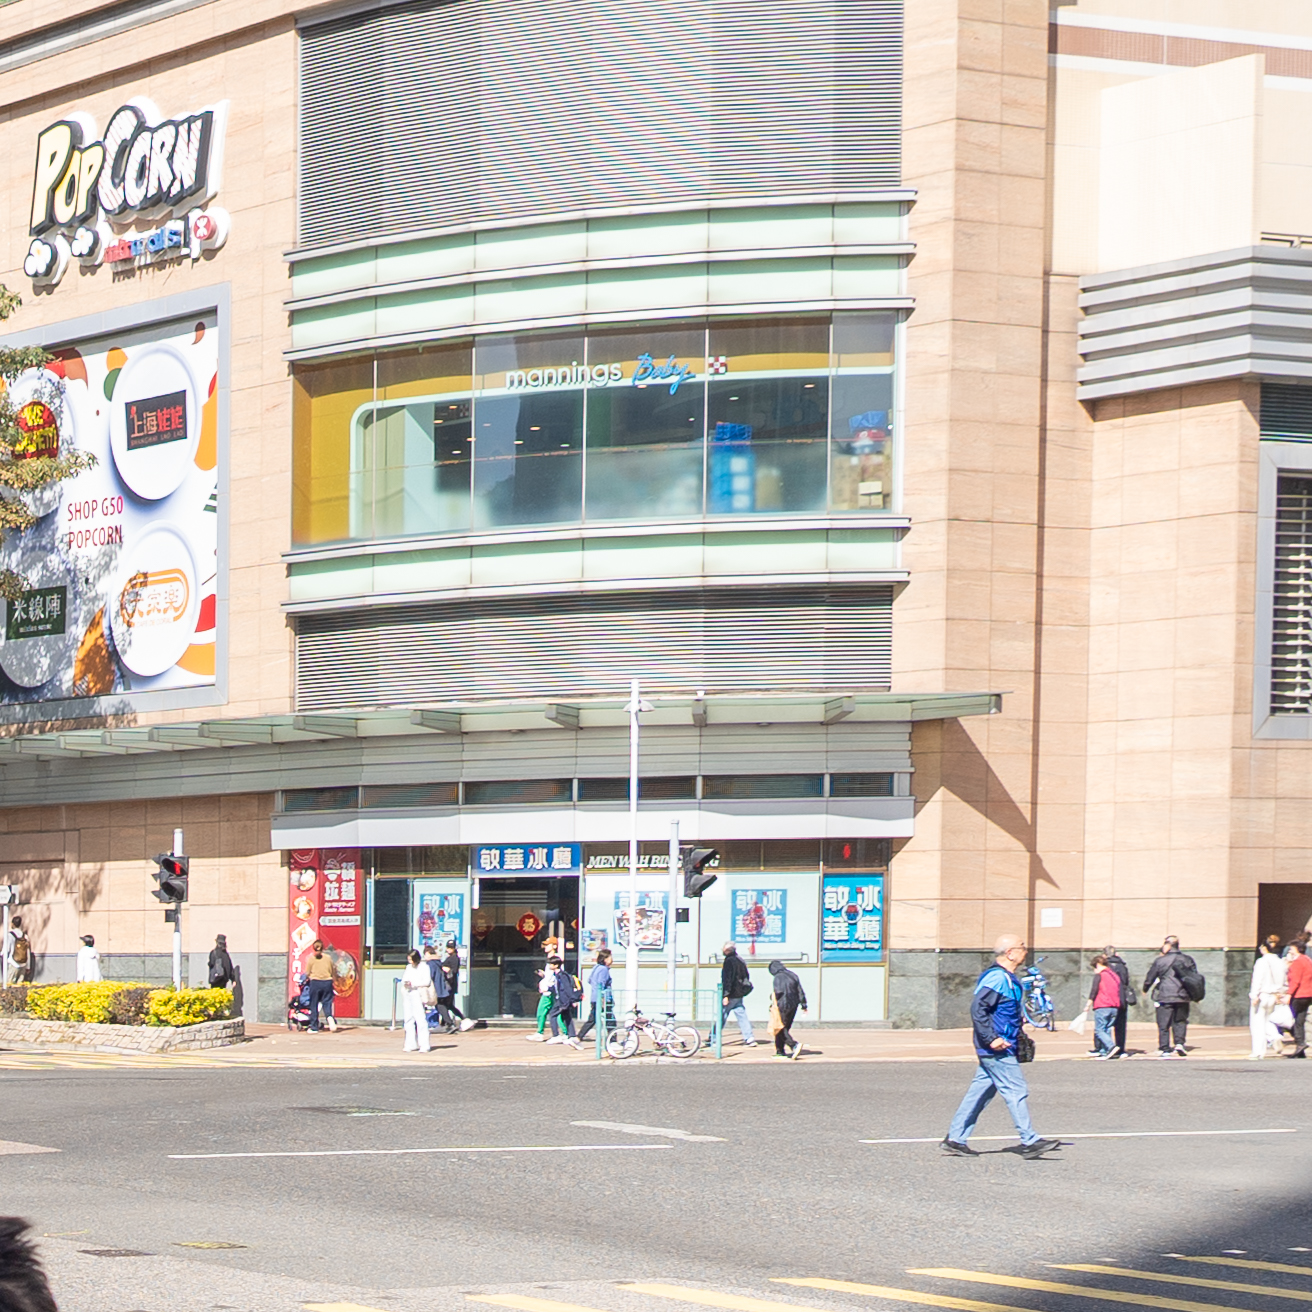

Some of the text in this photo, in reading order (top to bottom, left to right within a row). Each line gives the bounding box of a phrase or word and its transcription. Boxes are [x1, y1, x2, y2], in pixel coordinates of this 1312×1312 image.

[506, 353, 696, 396] mannings Baby
[68, 495, 123, 521] SHOP G50
[68, 525, 122, 550] POPCORN
